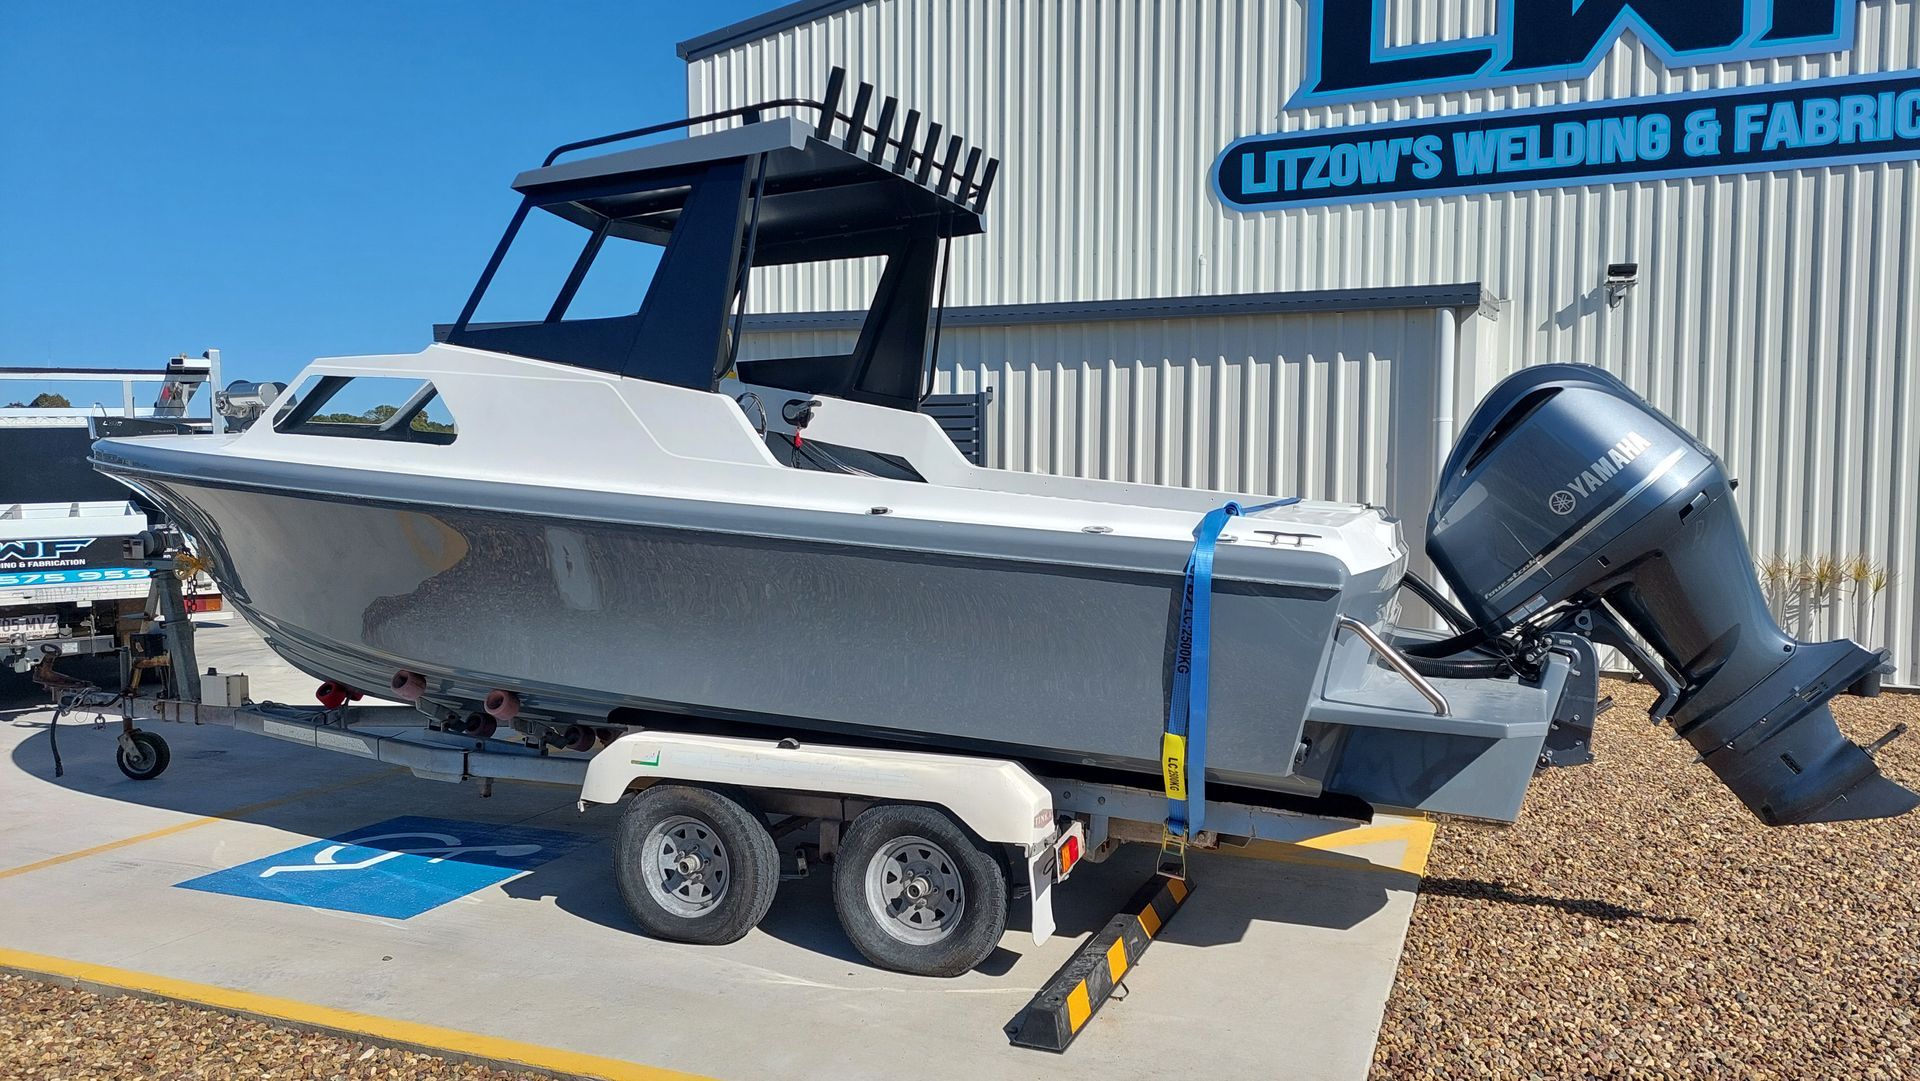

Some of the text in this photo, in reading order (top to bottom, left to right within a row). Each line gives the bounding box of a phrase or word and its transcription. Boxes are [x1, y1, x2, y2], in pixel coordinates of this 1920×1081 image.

[1242, 135, 1443, 194] LITZOW'S
[1452, 113, 1671, 176] WELDING
[1683, 108, 1721, 157] &
[1566, 431, 1652, 498] YAMAHA
[27, 559, 86, 568] FABRICATION
[0, 568, 150, 584] 575 959
[25, 615, 57, 631] MVZ
